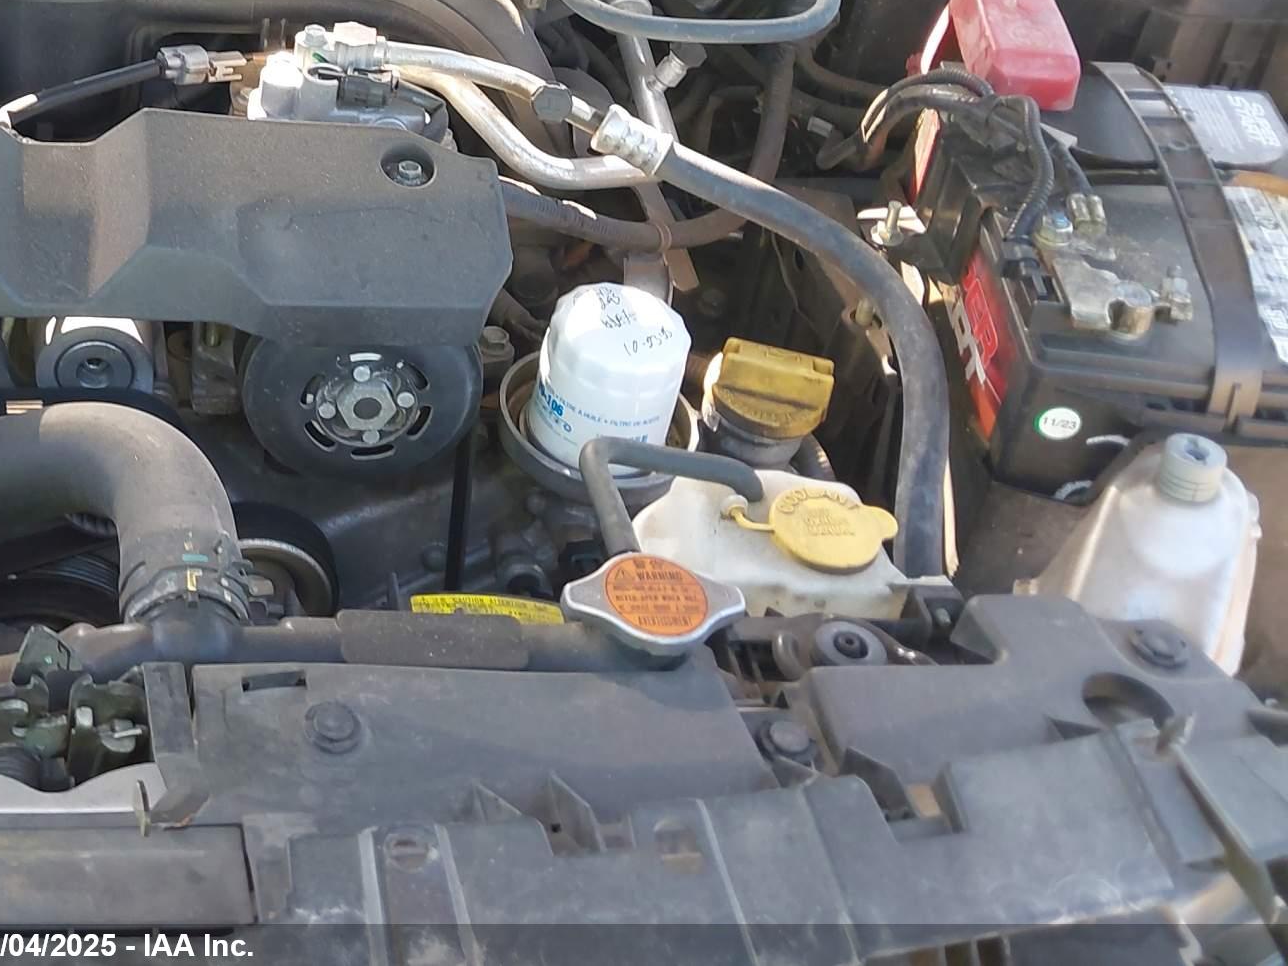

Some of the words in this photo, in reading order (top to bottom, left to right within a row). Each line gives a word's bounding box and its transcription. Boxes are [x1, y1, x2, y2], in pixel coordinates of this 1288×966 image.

[1226, 93, 1262, 143] START
[1249, 101, 1282, 147] SUPER
[1043, 416, 1077, 430] 11/23
[776, 487, 860, 514] COOLANT
[637, 570, 683, 581] WARNING
